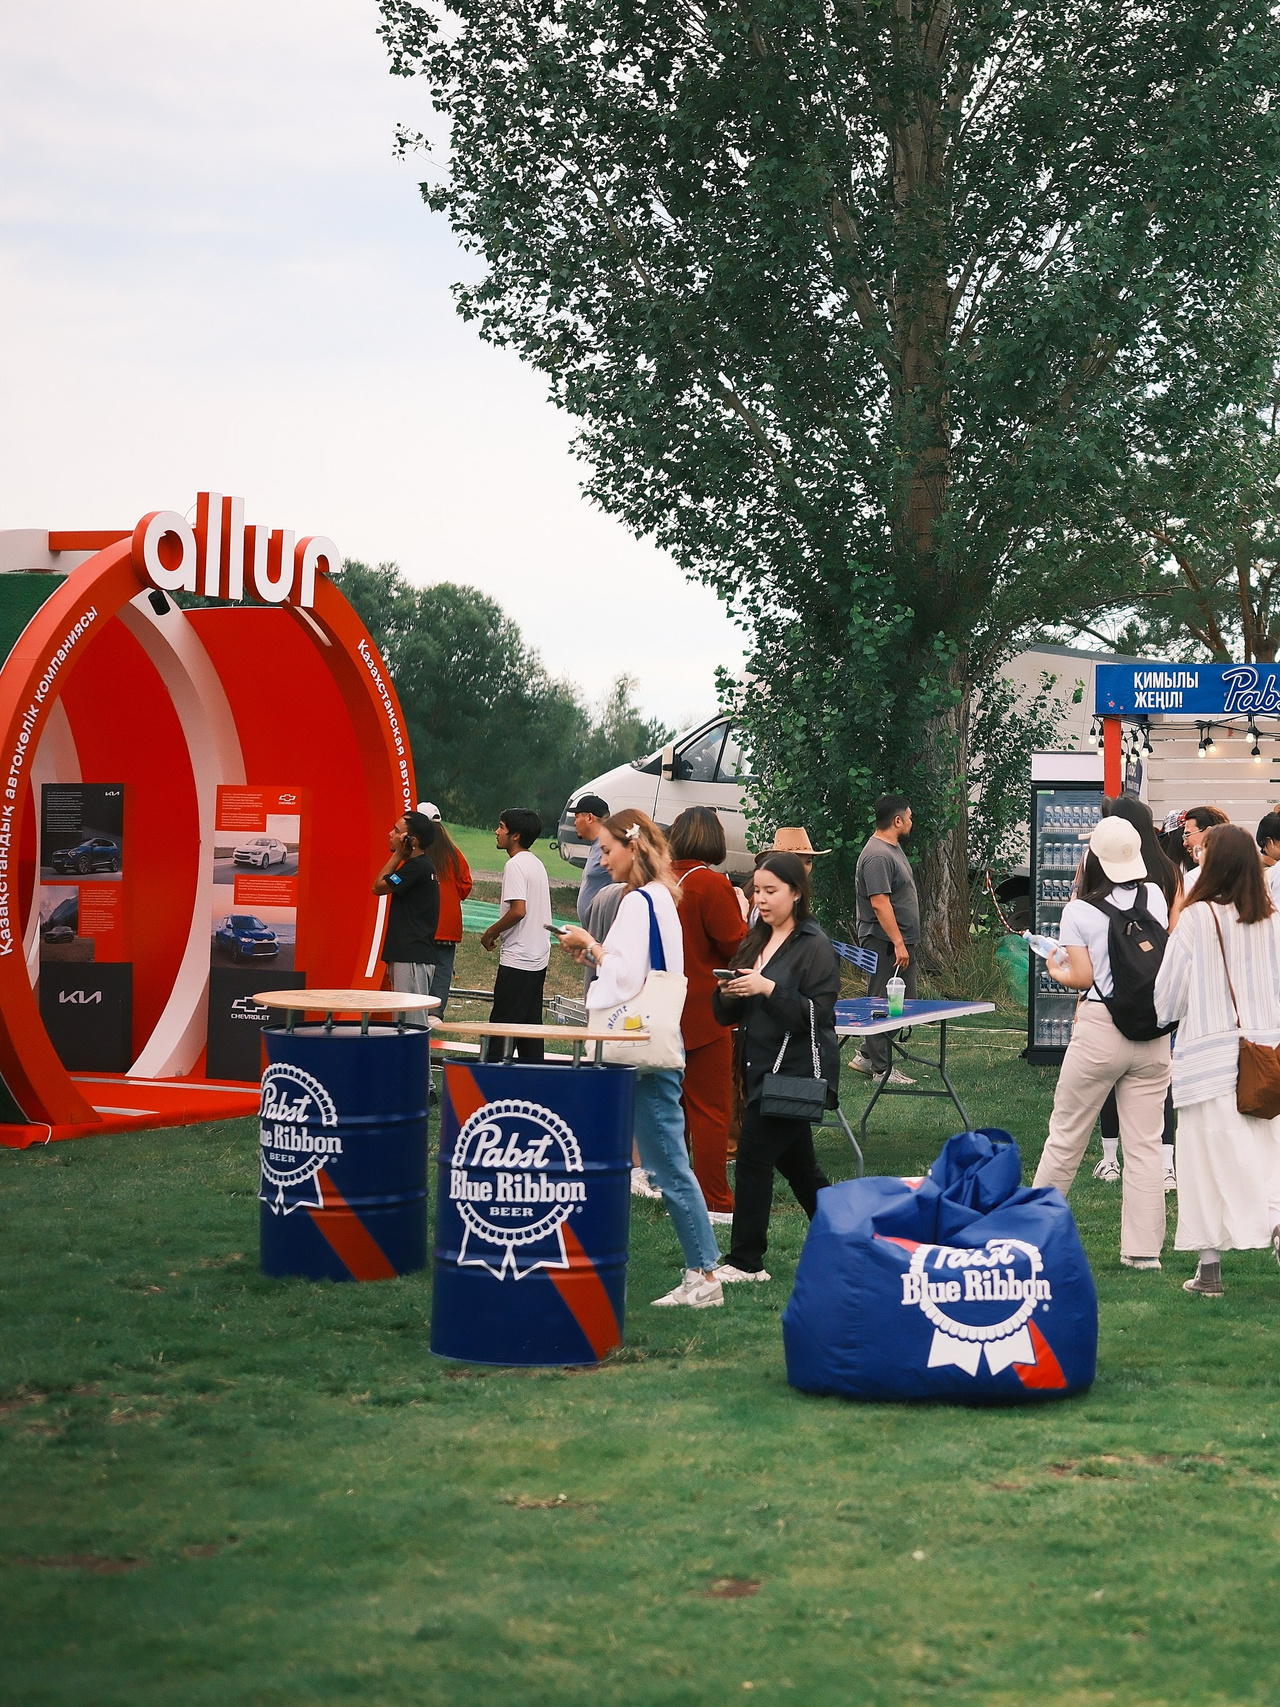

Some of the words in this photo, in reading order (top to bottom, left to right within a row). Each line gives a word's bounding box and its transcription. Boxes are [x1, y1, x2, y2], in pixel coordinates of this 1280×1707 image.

[131, 491, 341, 608] allur
[357, 638, 405, 757] Казахстанская
[1133, 671, 1199, 690] ҚИМЫЛЫ
[5, 704, 40, 800] автокөлік
[34, 606, 98, 703] компаниясы
[1134, 691, 1183, 710] ЖЕҢІЛ!
[231, 1013, 270, 1021] CHEVROLET
[259, 1081, 312, 1123] Pabst
[273, 1124, 343, 1154] Ribbon
[469, 1122, 553, 1169] Pabst
[269, 1152, 296, 1163] BEER
[450, 1168, 493, 1202] Blue
[496, 1171, 587, 1202] Ribbon
[489, 1206, 534, 1217] BEER
[901, 1271, 961, 1305] Blue
[963, 1269, 1052, 1302] Ribbon
